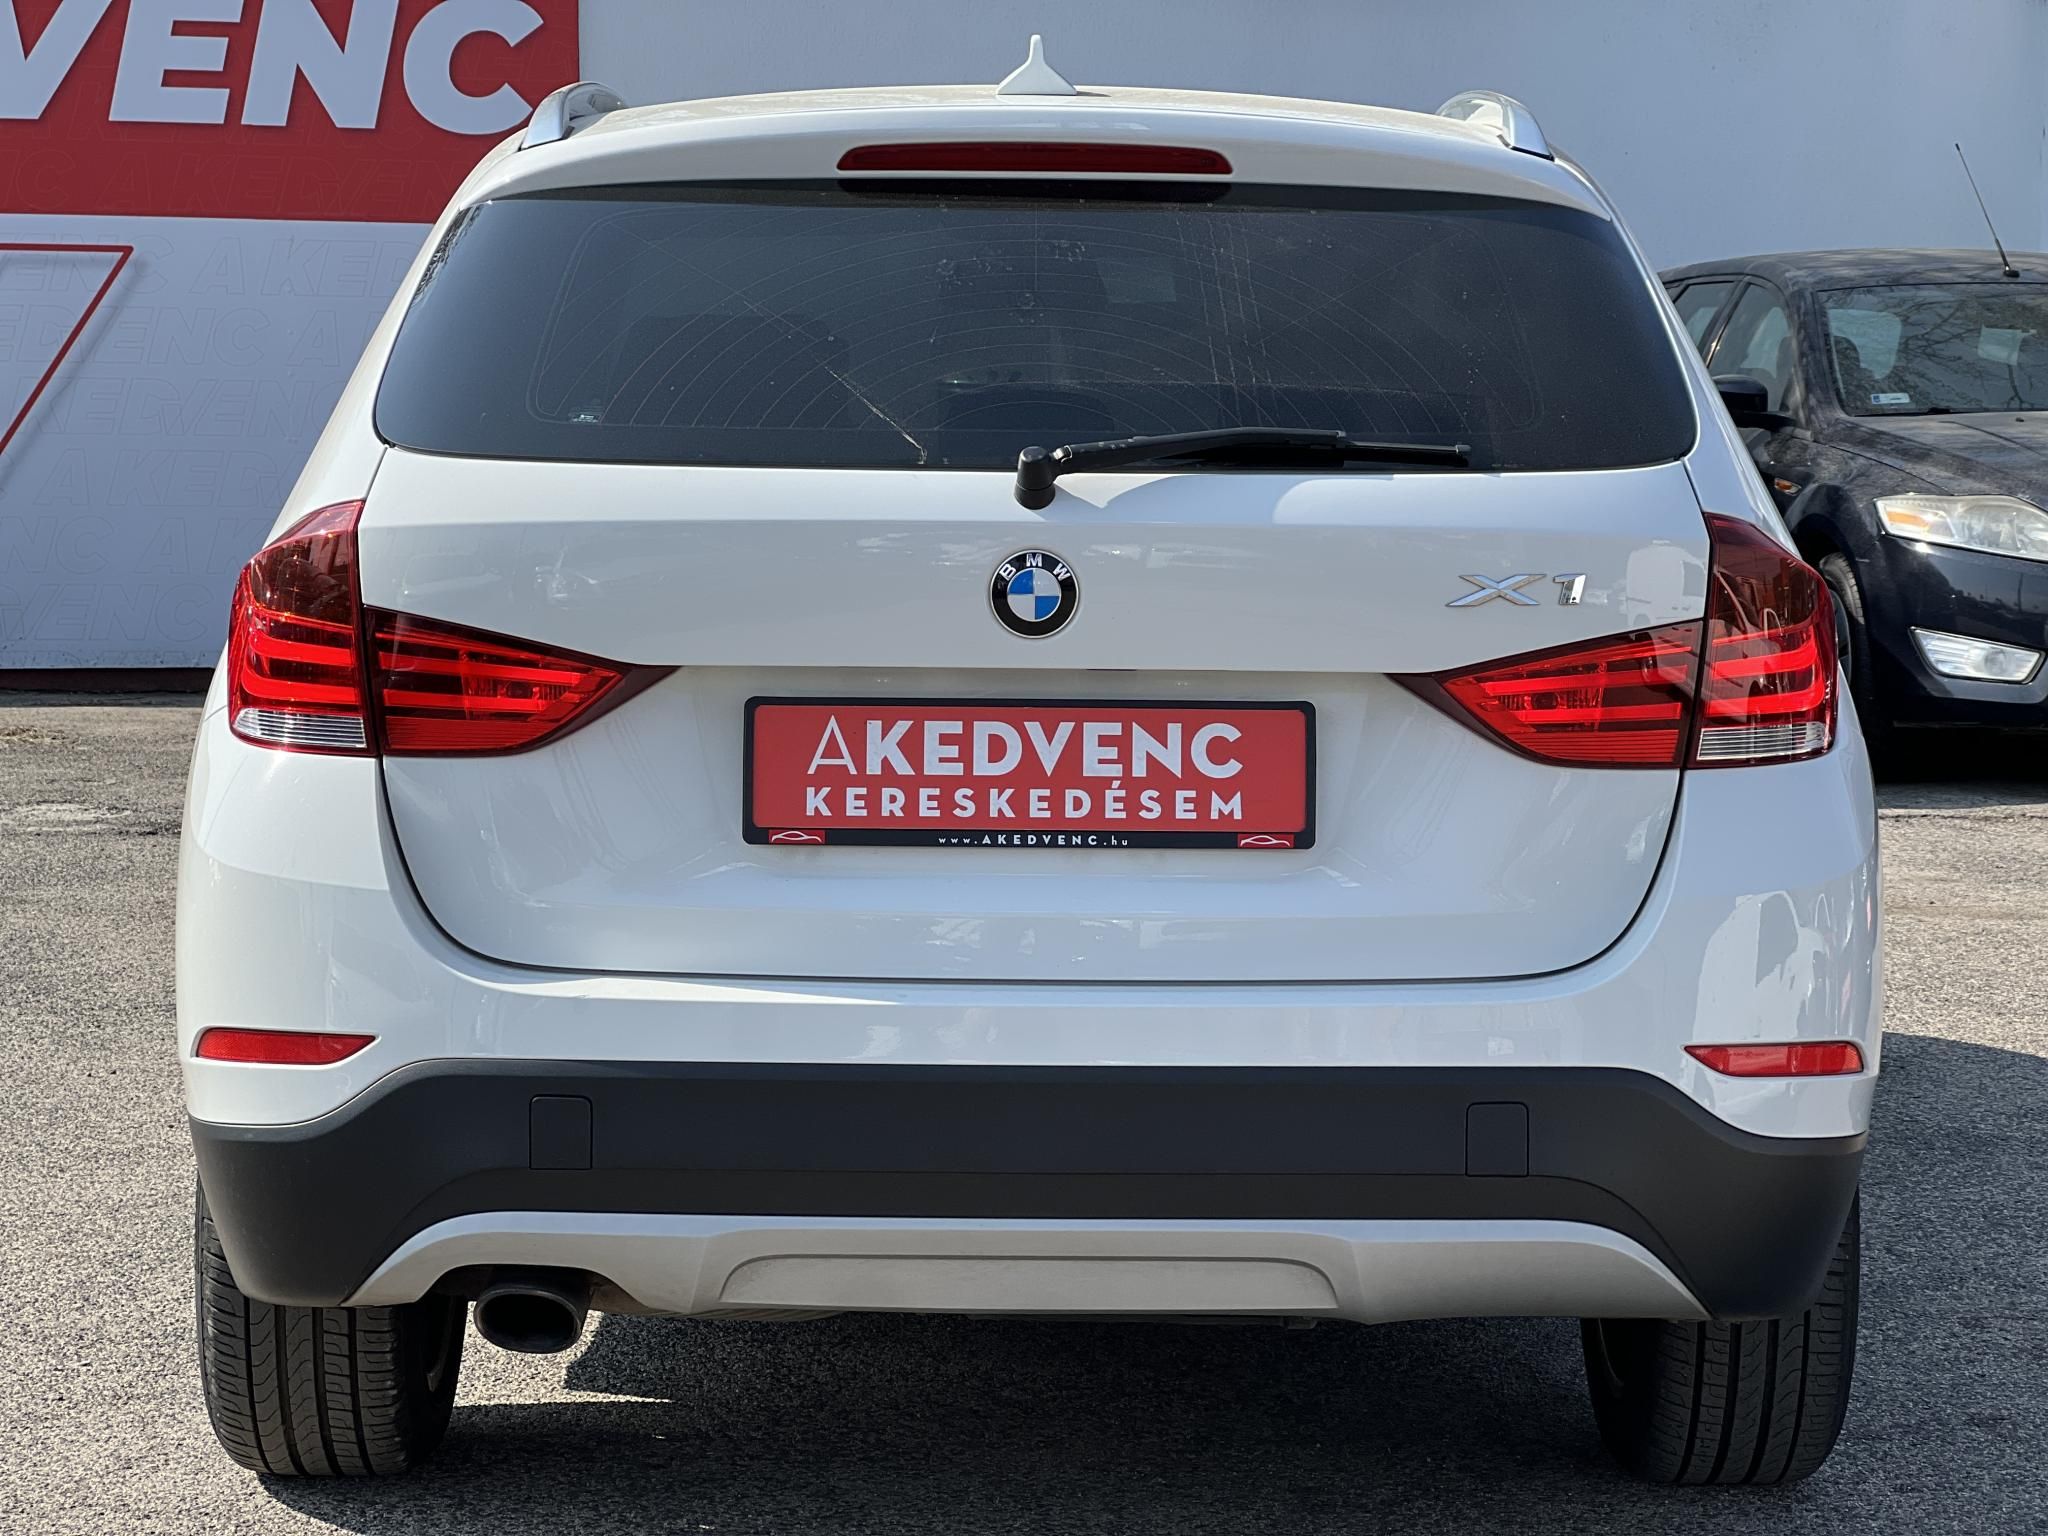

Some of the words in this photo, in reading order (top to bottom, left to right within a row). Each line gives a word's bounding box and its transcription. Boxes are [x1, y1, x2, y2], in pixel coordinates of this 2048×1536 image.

[189, 236, 246, 296] A
[285, 310, 341, 367] A
[32, 448, 91, 506] A
[131, 516, 191, 576] A
[999, 553, 1071, 581] BMW
[1446, 574, 1587, 606] X1
[806, 780, 1242, 820] KERESKEDÉSEM
[938, 834, 1129, 846] www.AKEDVENC.hu
